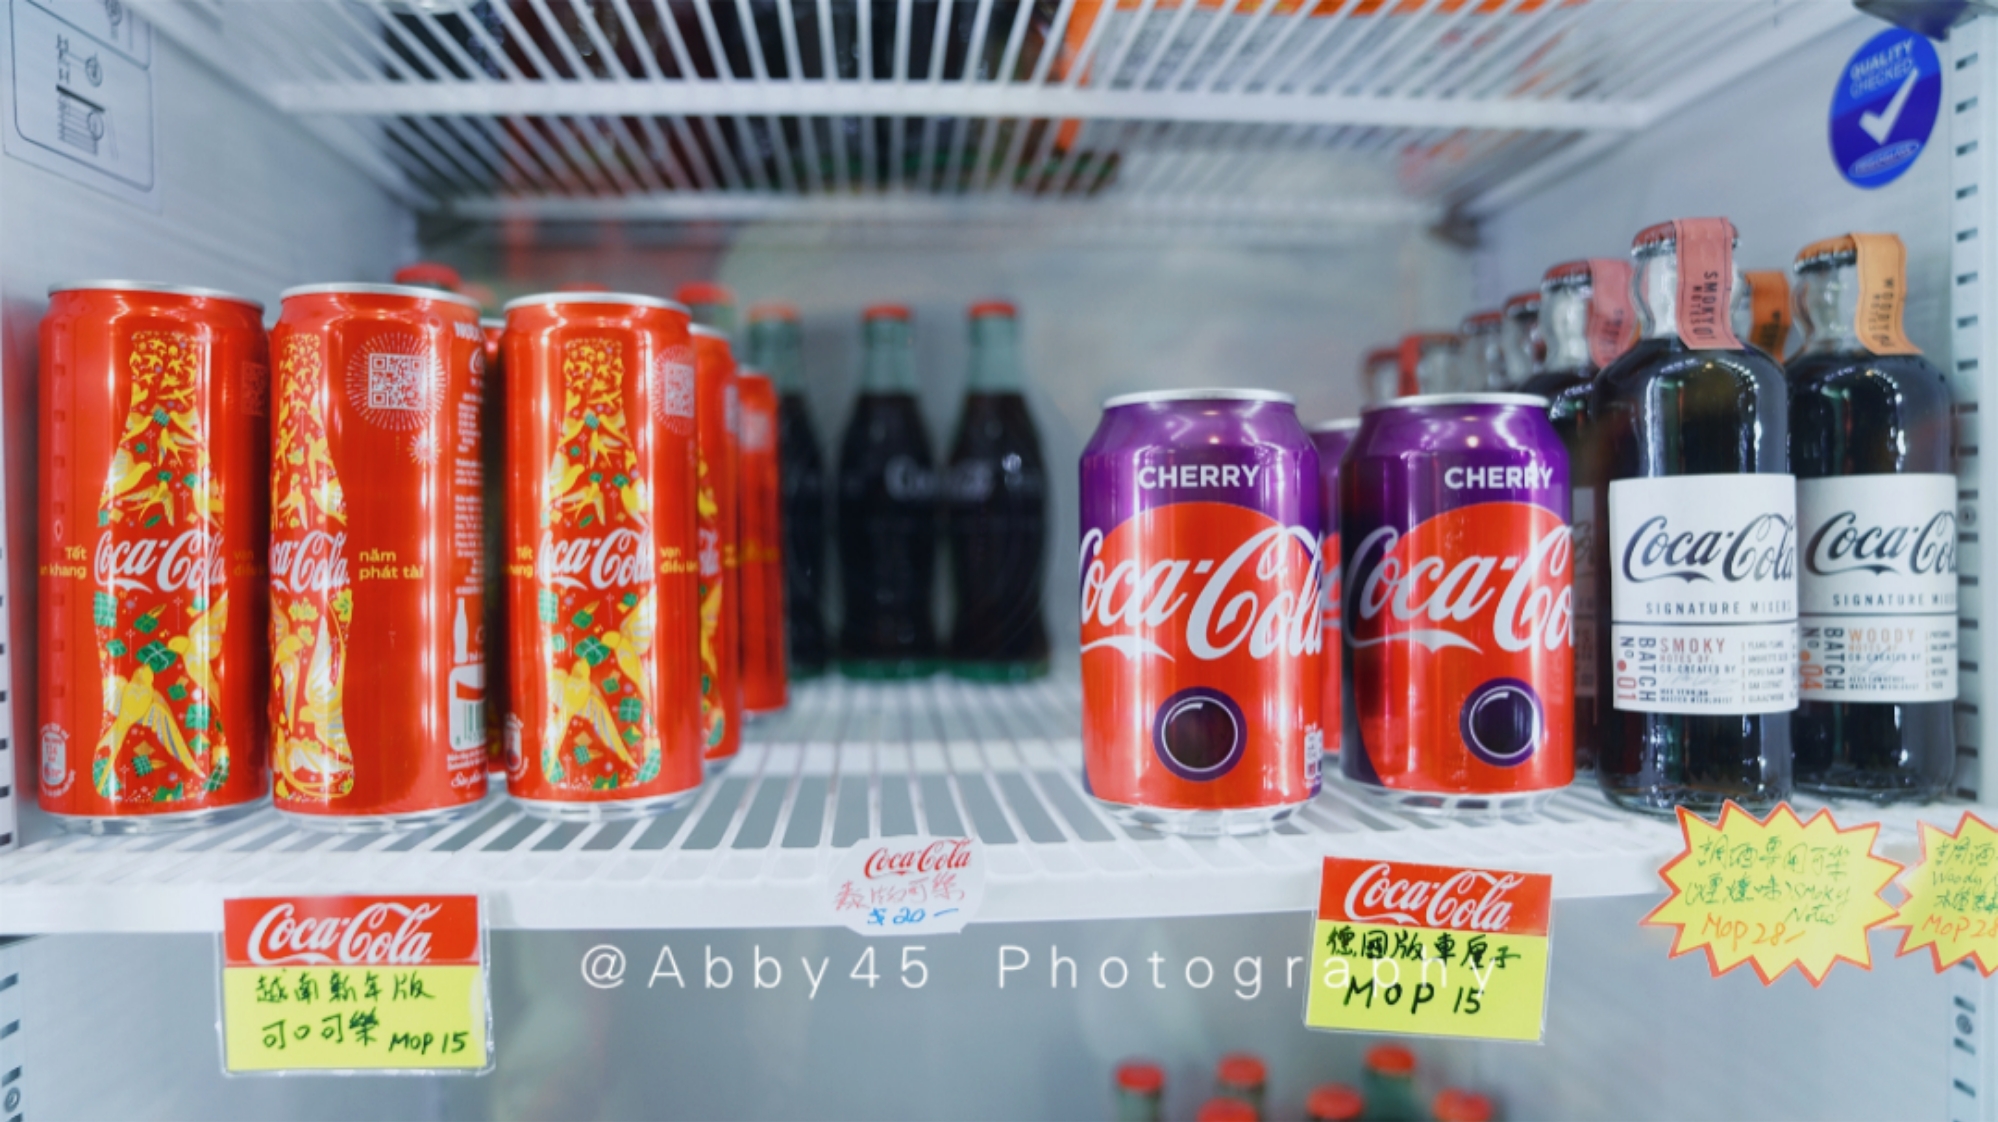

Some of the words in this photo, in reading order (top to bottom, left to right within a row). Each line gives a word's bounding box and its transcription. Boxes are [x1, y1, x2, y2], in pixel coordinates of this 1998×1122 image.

[1852, 38, 1913, 80] QUALITY
[1851, 58, 1913, 99] CHECKED
[1702, 271, 1718, 325] SMOKY
[1138, 465, 1259, 490] CHERRY
[1444, 466, 1553, 490] CHERRY
[359, 547, 397, 562] năm
[49, 562, 87, 581] khang
[359, 564, 399, 582] phát
[1345, 524, 1576, 655] Coca-Co
[1833, 593, 1924, 607] SIGNATURE
[1646, 601, 1740, 616] SIGNATURE
[1660, 637, 1726, 655] SMOKY
[1848, 628, 1915, 643] WOODY
[1638, 636, 1657, 702] BATCH
[1824, 626, 1845, 690] BATCH
[864, 838, 975, 880] Coca-Cola
[1343, 861, 1526, 932] Coca-Cola
[247, 902, 442, 965] Coca-Cola
[1342, 974, 1435, 1015] MOP
[1453, 986, 1485, 1015] 15
[388, 1030, 434, 1055] MOP
[441, 1030, 470, 1054] 15
